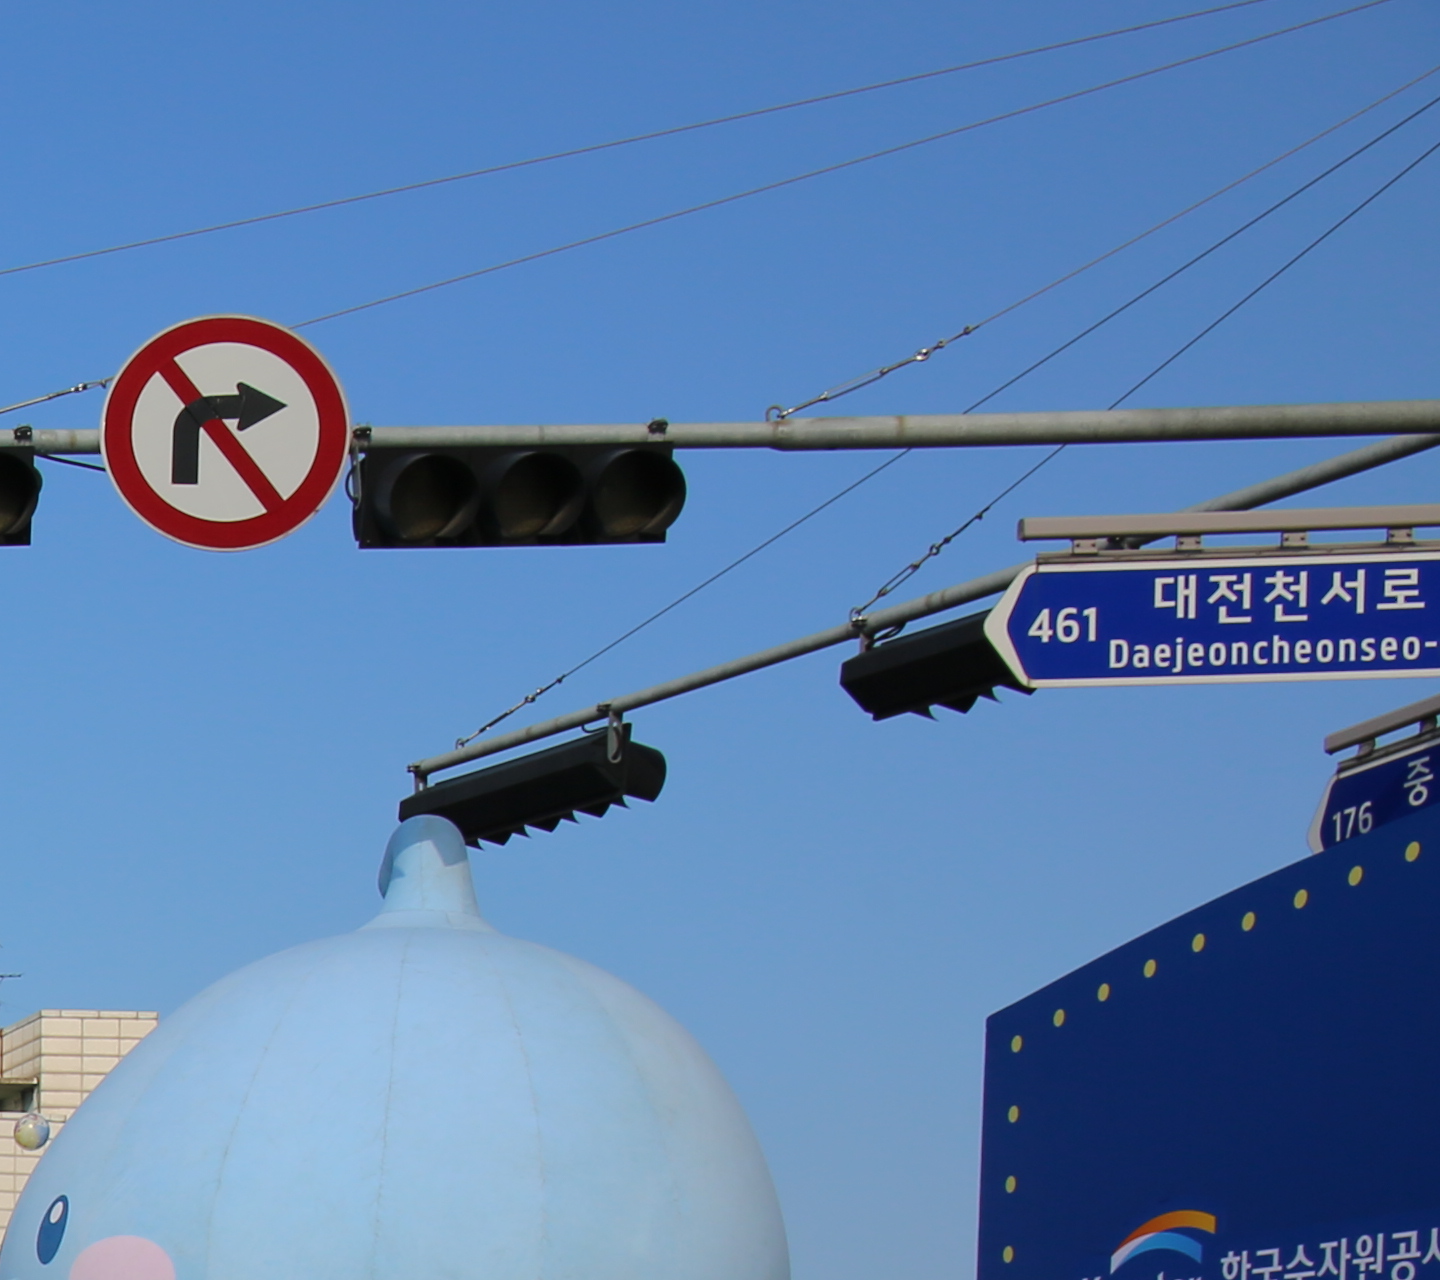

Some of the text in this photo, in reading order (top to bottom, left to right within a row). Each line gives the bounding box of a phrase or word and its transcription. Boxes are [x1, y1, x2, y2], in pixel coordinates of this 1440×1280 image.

[1028, 567, 1426, 644] 461 대전천서로
[1109, 634, 1439, 674] Daejeoncheonseo-
[1332, 755, 1434, 843] 176 중
